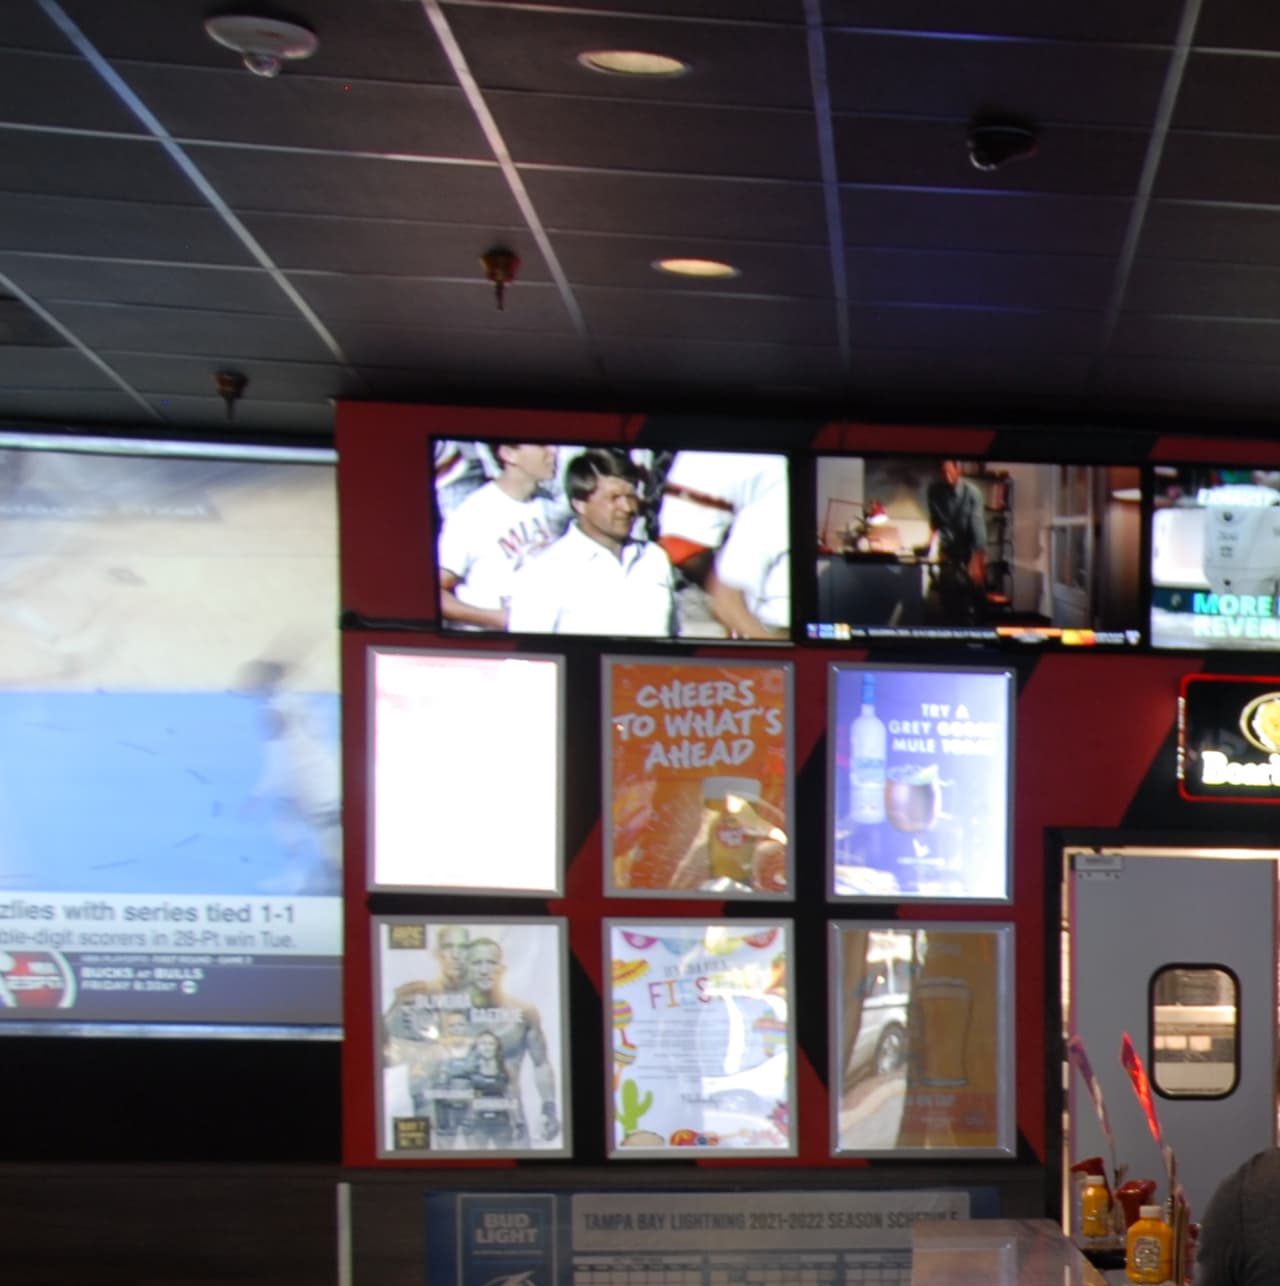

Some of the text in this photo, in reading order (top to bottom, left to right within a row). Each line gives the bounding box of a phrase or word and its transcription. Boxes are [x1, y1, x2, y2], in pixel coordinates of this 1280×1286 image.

[1193, 594, 1274, 616] MORE
[636, 679, 754, 709] CHEERS
[921, 703, 970, 719] TRY A
[612, 708, 783, 741] TO WHAT'S
[889, 721, 931, 735] GREY
[645, 739, 755, 771] AHEAD
[892, 738, 935, 753] MULE
[64, 901, 115, 922] with
[123, 902, 198, 923] series
[206, 902, 250, 923] tied
[261, 904, 295, 923] 1-1
[80, 932, 147, 947] scorers
[152, 930, 169, 947] in
[225, 931, 256, 948] win
[260, 931, 296, 949] Tue.
[80, 967, 133, 979] BUCKS
[154, 968, 204, 980] BULLS
[484, 1213, 530, 1228] BUD
[584, 1213, 634, 1231] TAMPA
[637, 1212, 665, 1230] BAY
[671, 1212, 746, 1230] LIGHTNING
[749, 1211, 825, 1230] 2021-2022
[827, 1211, 883, 1230] SEASON
[475, 1228, 538, 1244] LIGHT
